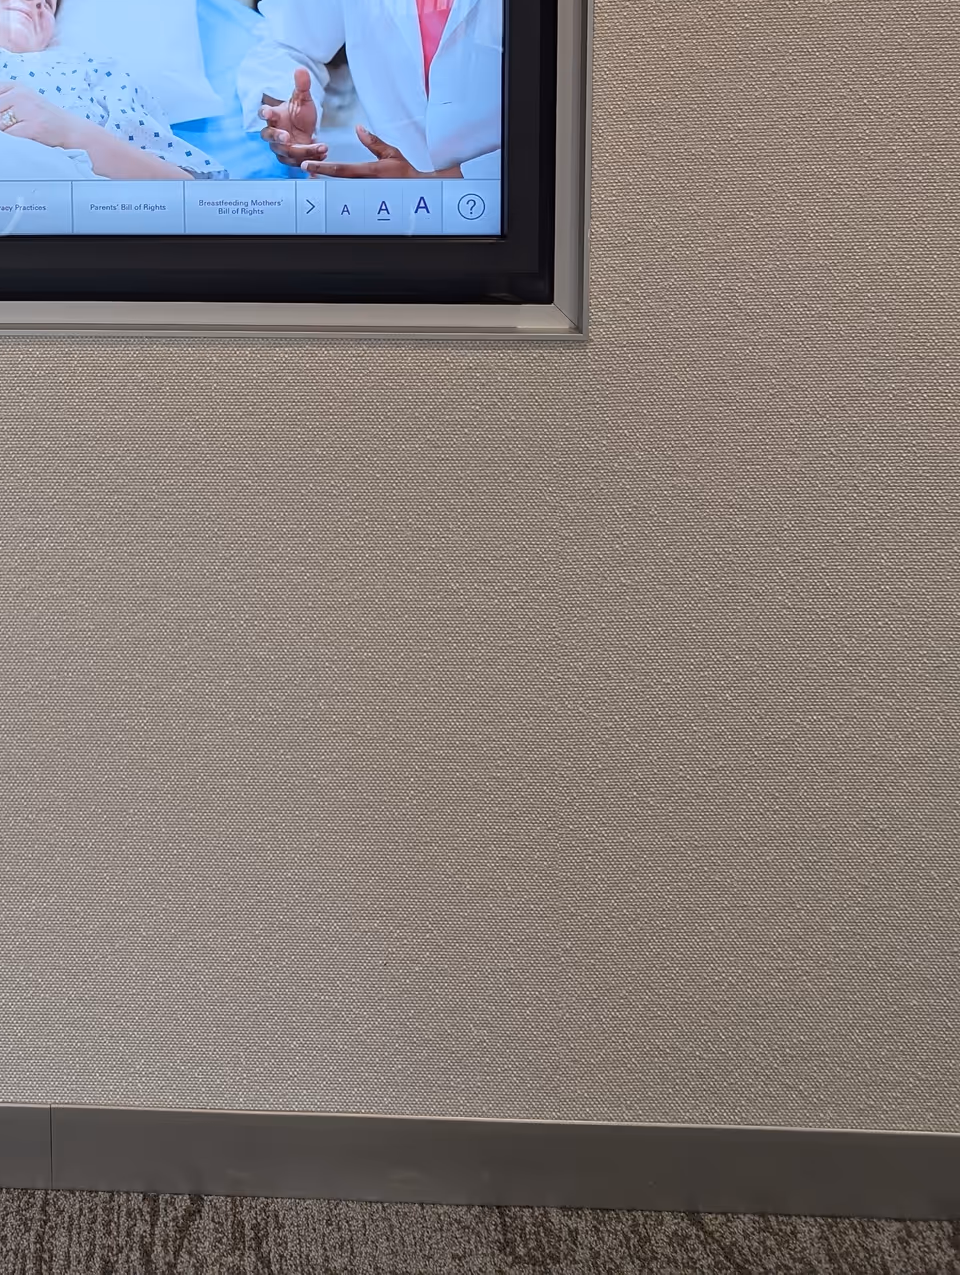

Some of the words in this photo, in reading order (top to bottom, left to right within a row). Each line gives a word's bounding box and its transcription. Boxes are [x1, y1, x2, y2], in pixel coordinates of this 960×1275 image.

[341, 204, 350, 215] A
[377, 201, 390, 215] A
[414, 197, 430, 214] A
